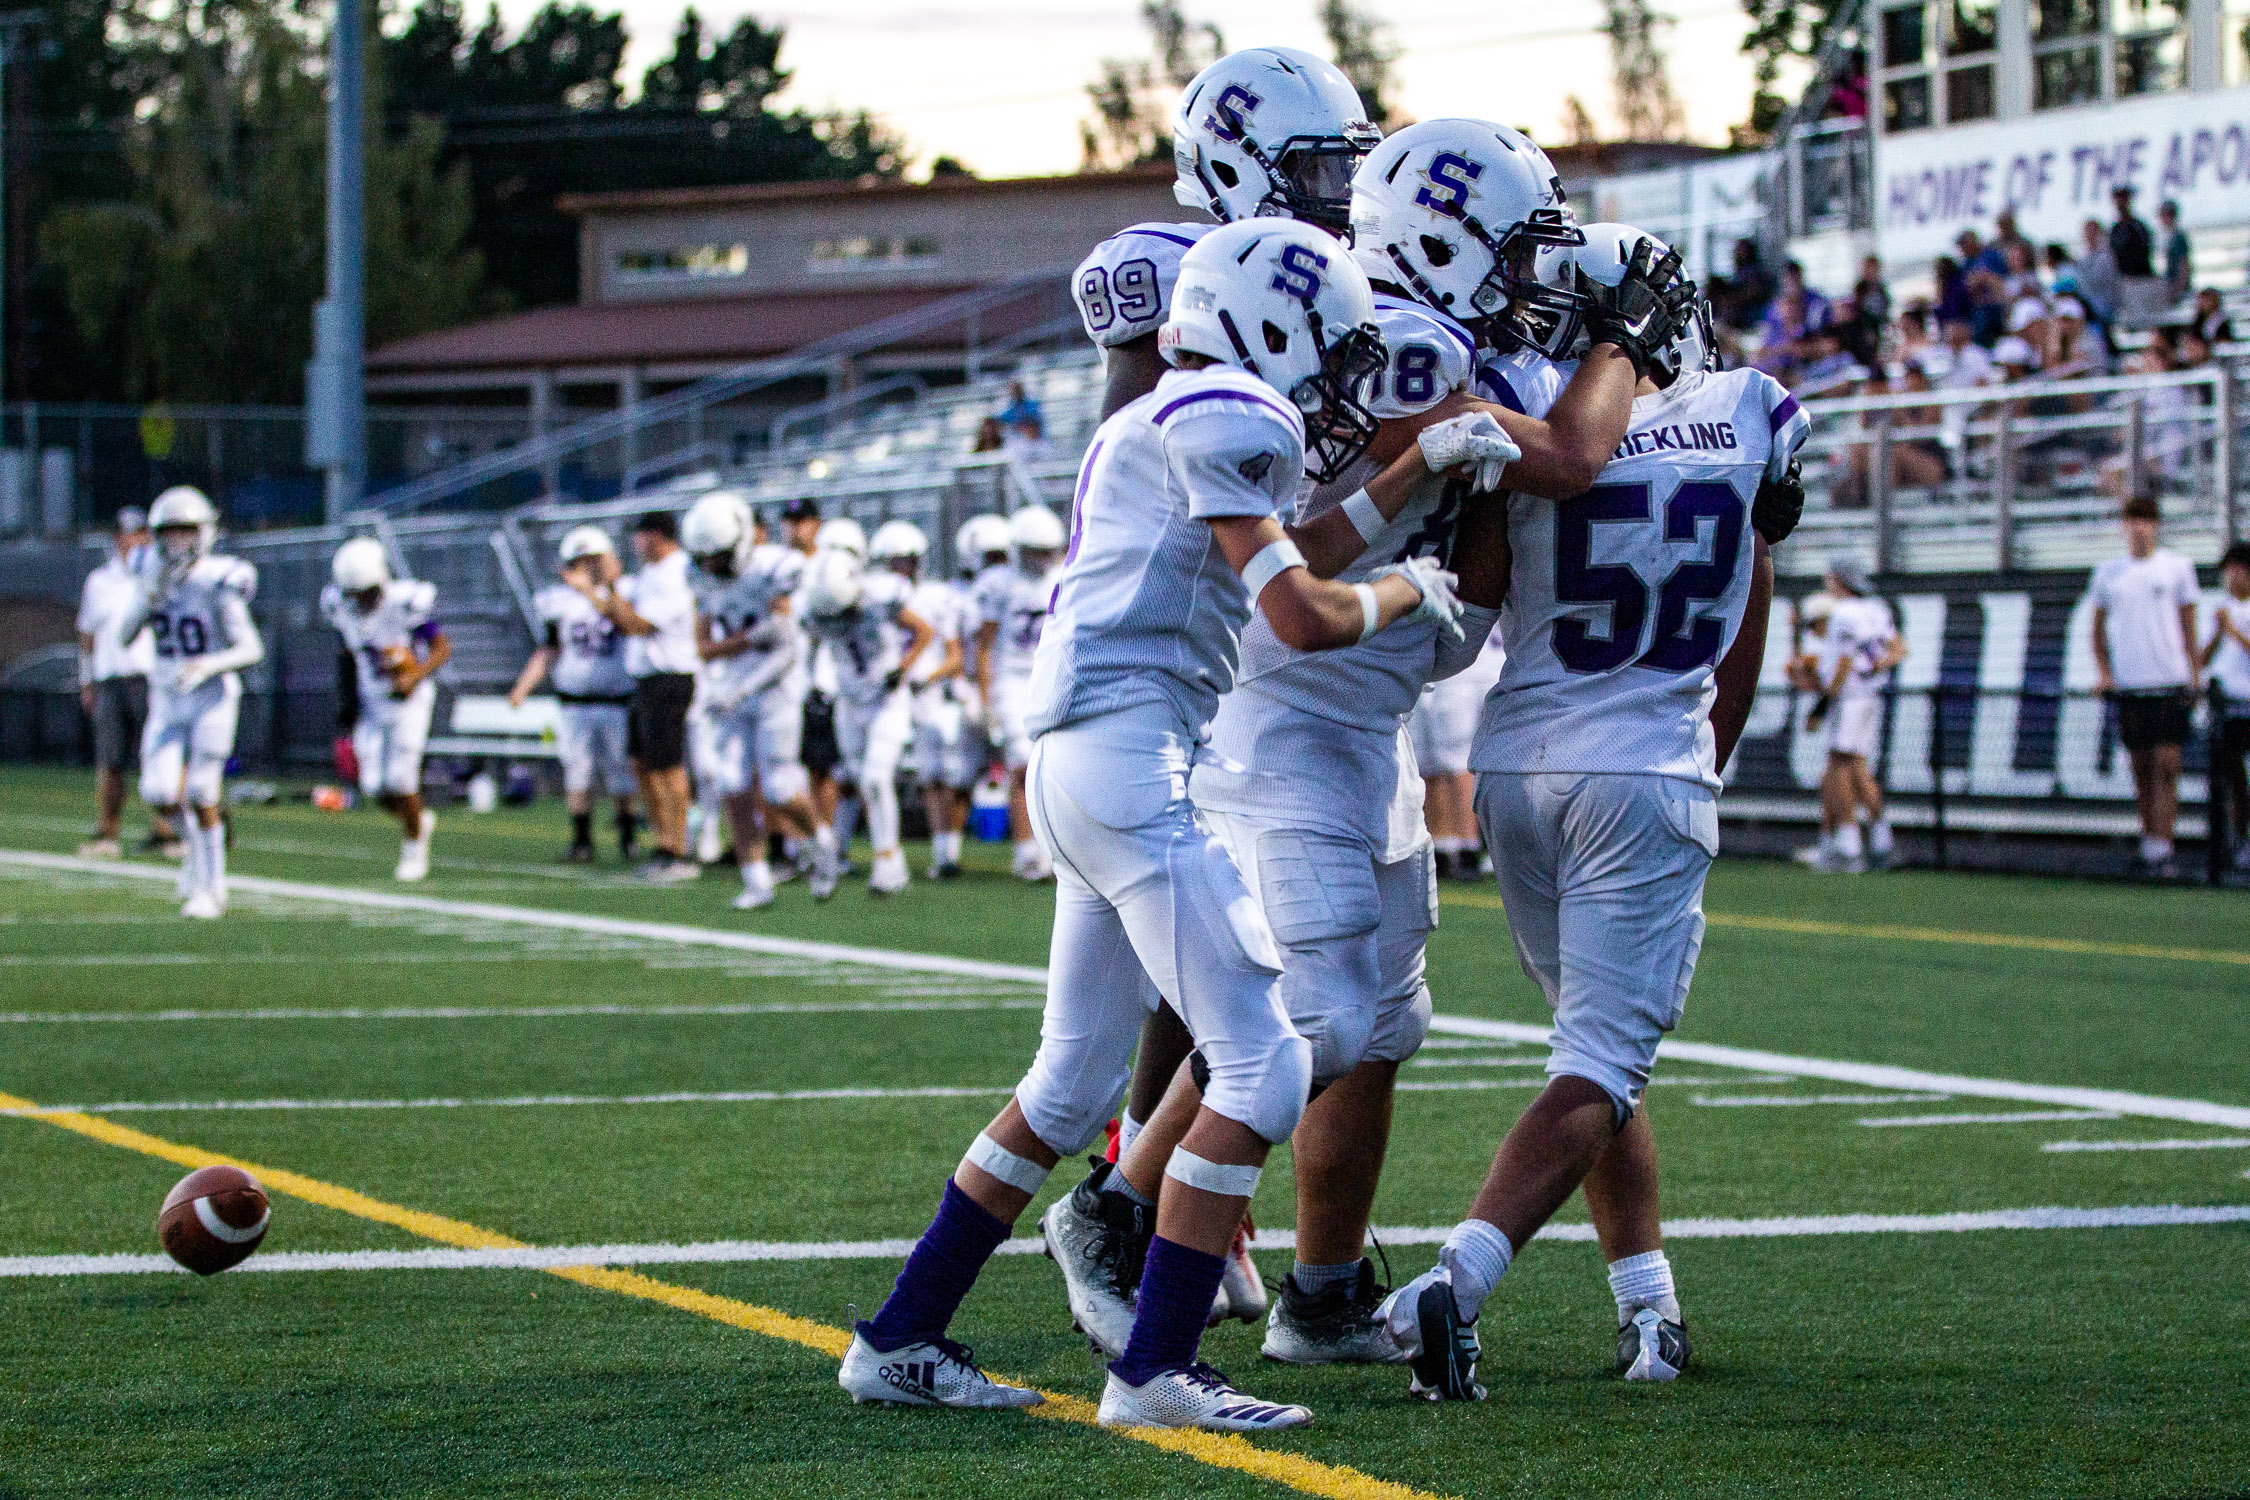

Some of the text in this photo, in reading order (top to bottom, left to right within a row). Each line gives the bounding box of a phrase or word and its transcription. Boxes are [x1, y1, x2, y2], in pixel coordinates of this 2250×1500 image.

[1203, 82, 1263, 143] S
[1414, 151, 1486, 219] S
[1887, 124, 2250, 226] HOME OF THE APO
[1079, 258, 1162, 331] 89
[1269, 243, 1330, 300] S
[1550, 478, 1748, 675] 52
[148, 611, 206, 656] 20
